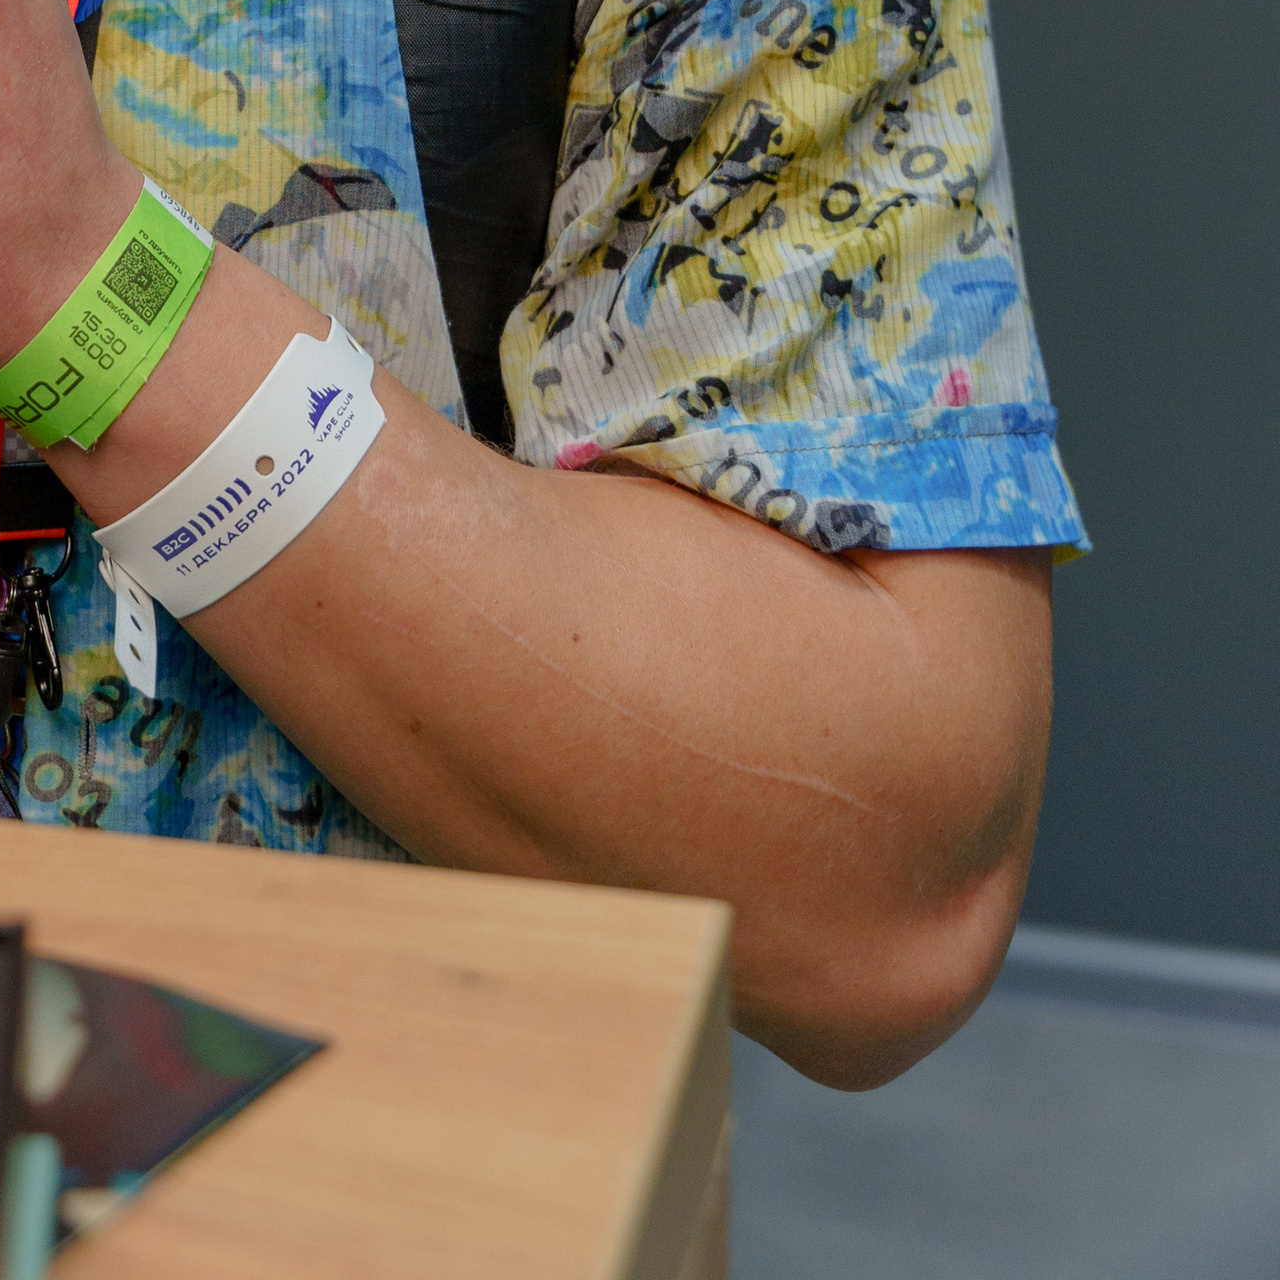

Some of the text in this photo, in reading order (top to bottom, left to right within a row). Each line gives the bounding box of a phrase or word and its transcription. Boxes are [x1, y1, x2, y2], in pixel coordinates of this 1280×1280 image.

[67, 325, 114, 371] 18.00
[81, 309, 127, 356] 15.30
[316, 391, 356, 442] VAPE CLUB
[335, 410, 357, 441] SHOW
[193, 497, 272, 570] ДЕКАБРЯ
[271, 447, 315, 498] 2022
[161, 530, 191, 557] B2C
